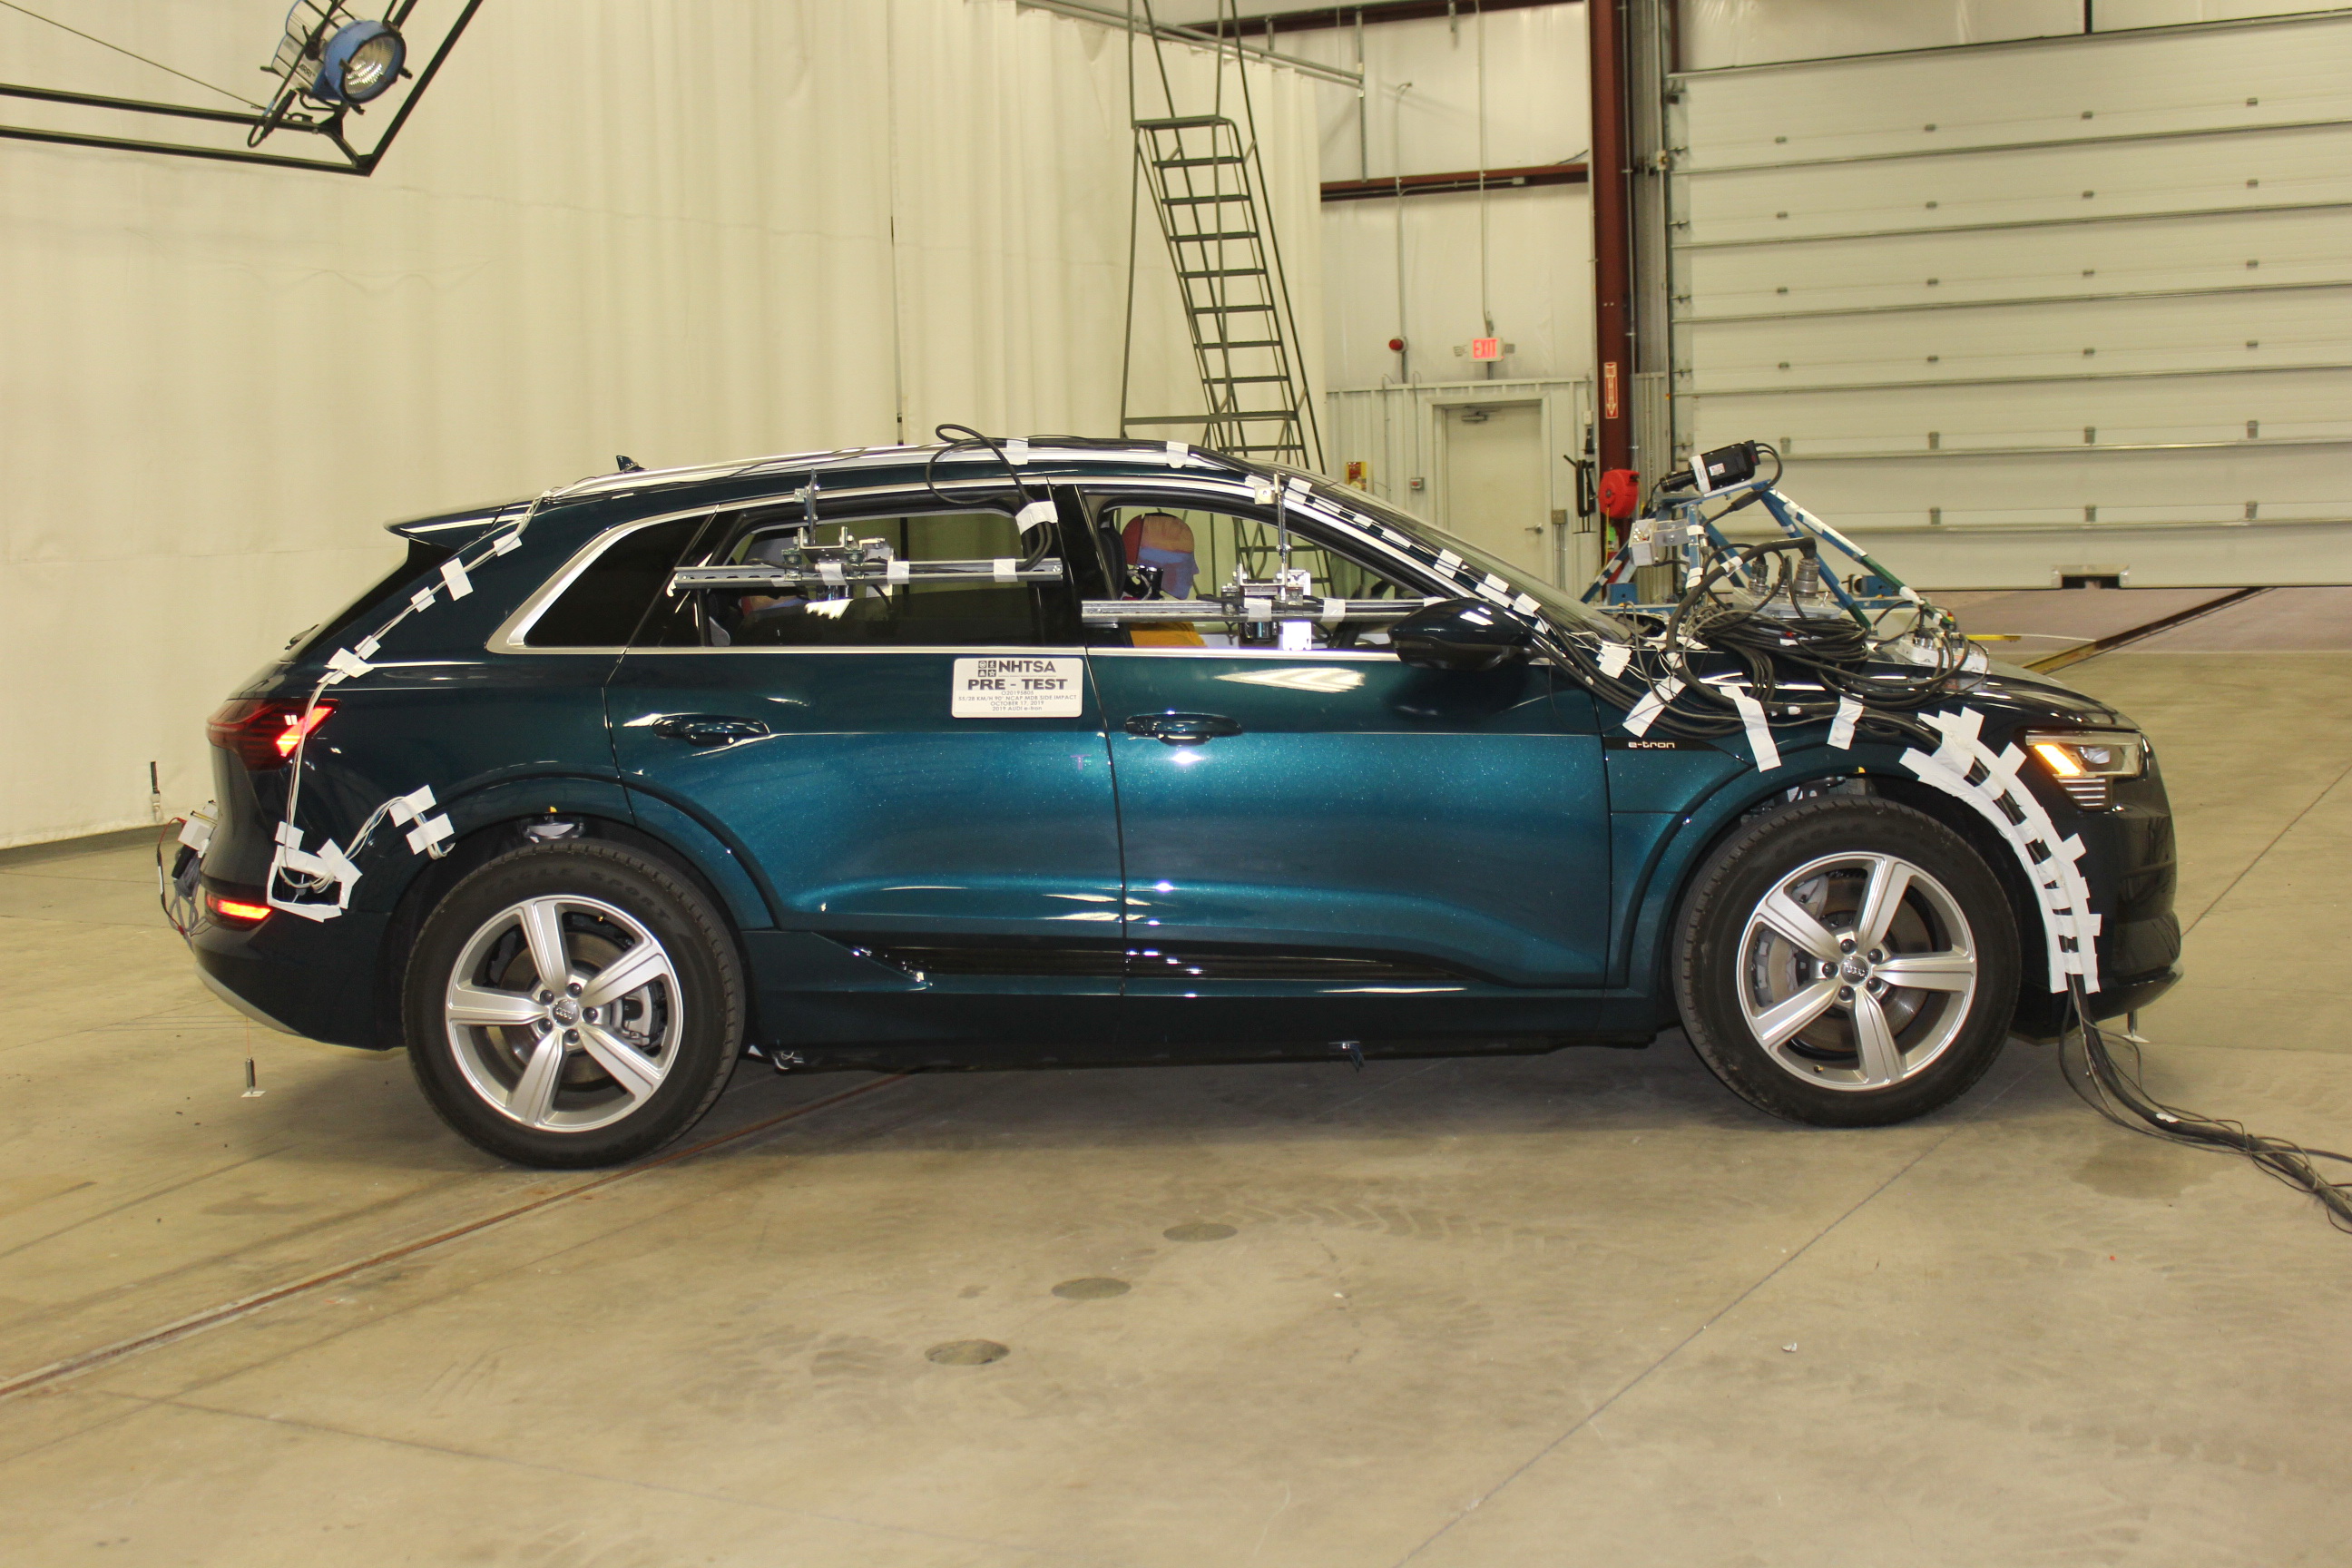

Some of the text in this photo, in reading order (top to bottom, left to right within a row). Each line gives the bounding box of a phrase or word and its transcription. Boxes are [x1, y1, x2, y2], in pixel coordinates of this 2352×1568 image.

[1473, 338, 1498, 359] EXIT
[998, 660, 1056, 672] NHTSA
[967, 679, 1005, 690] PRE
[1021, 678, 1068, 690] TEST
[1628, 740, 1676, 749] e-tron
[590, 871, 671, 920] SPORT
